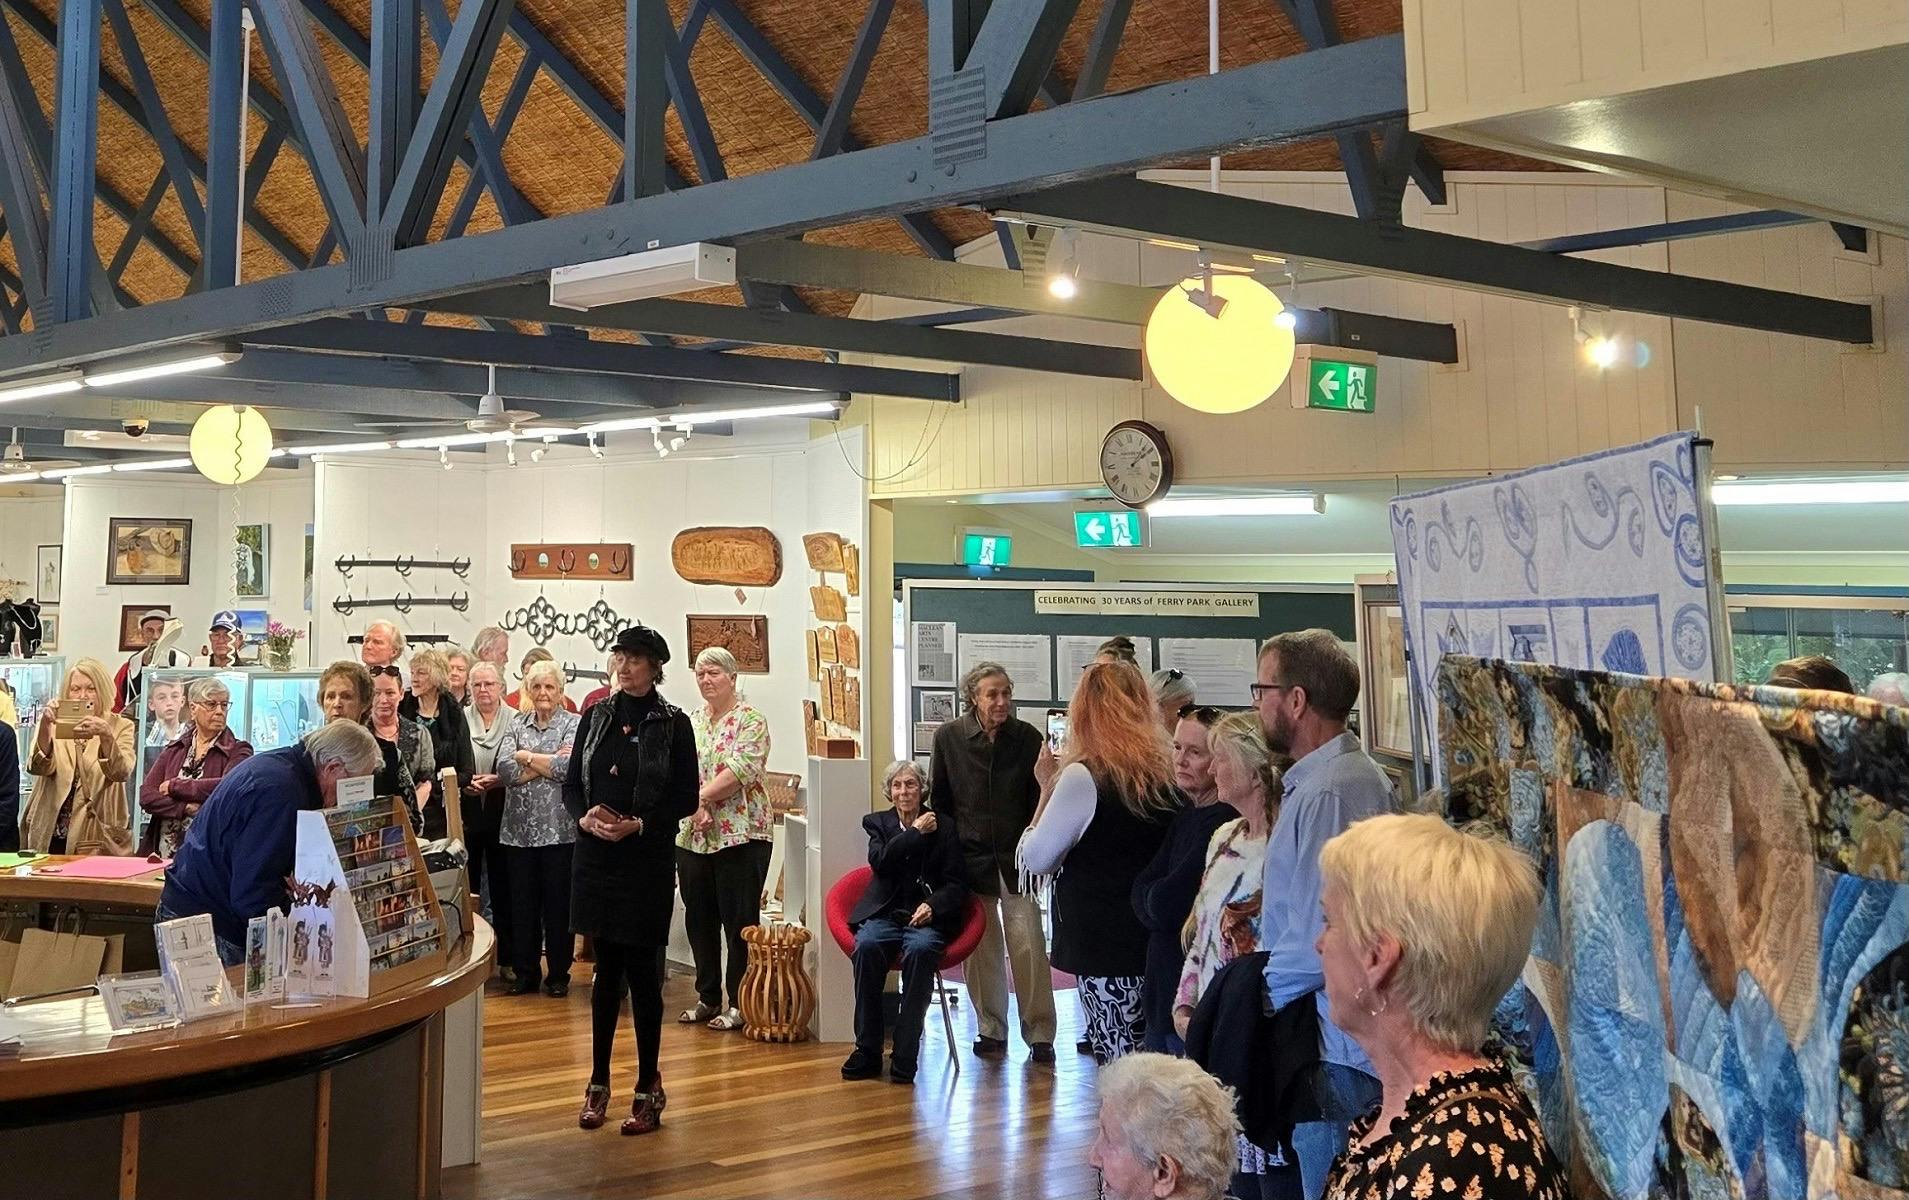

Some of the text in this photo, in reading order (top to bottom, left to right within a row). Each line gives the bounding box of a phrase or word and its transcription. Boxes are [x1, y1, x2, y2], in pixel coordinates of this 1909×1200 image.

[1038, 596, 1254, 607] CELEBRATING 30 YEARS of FERRY PARK GALLERY
